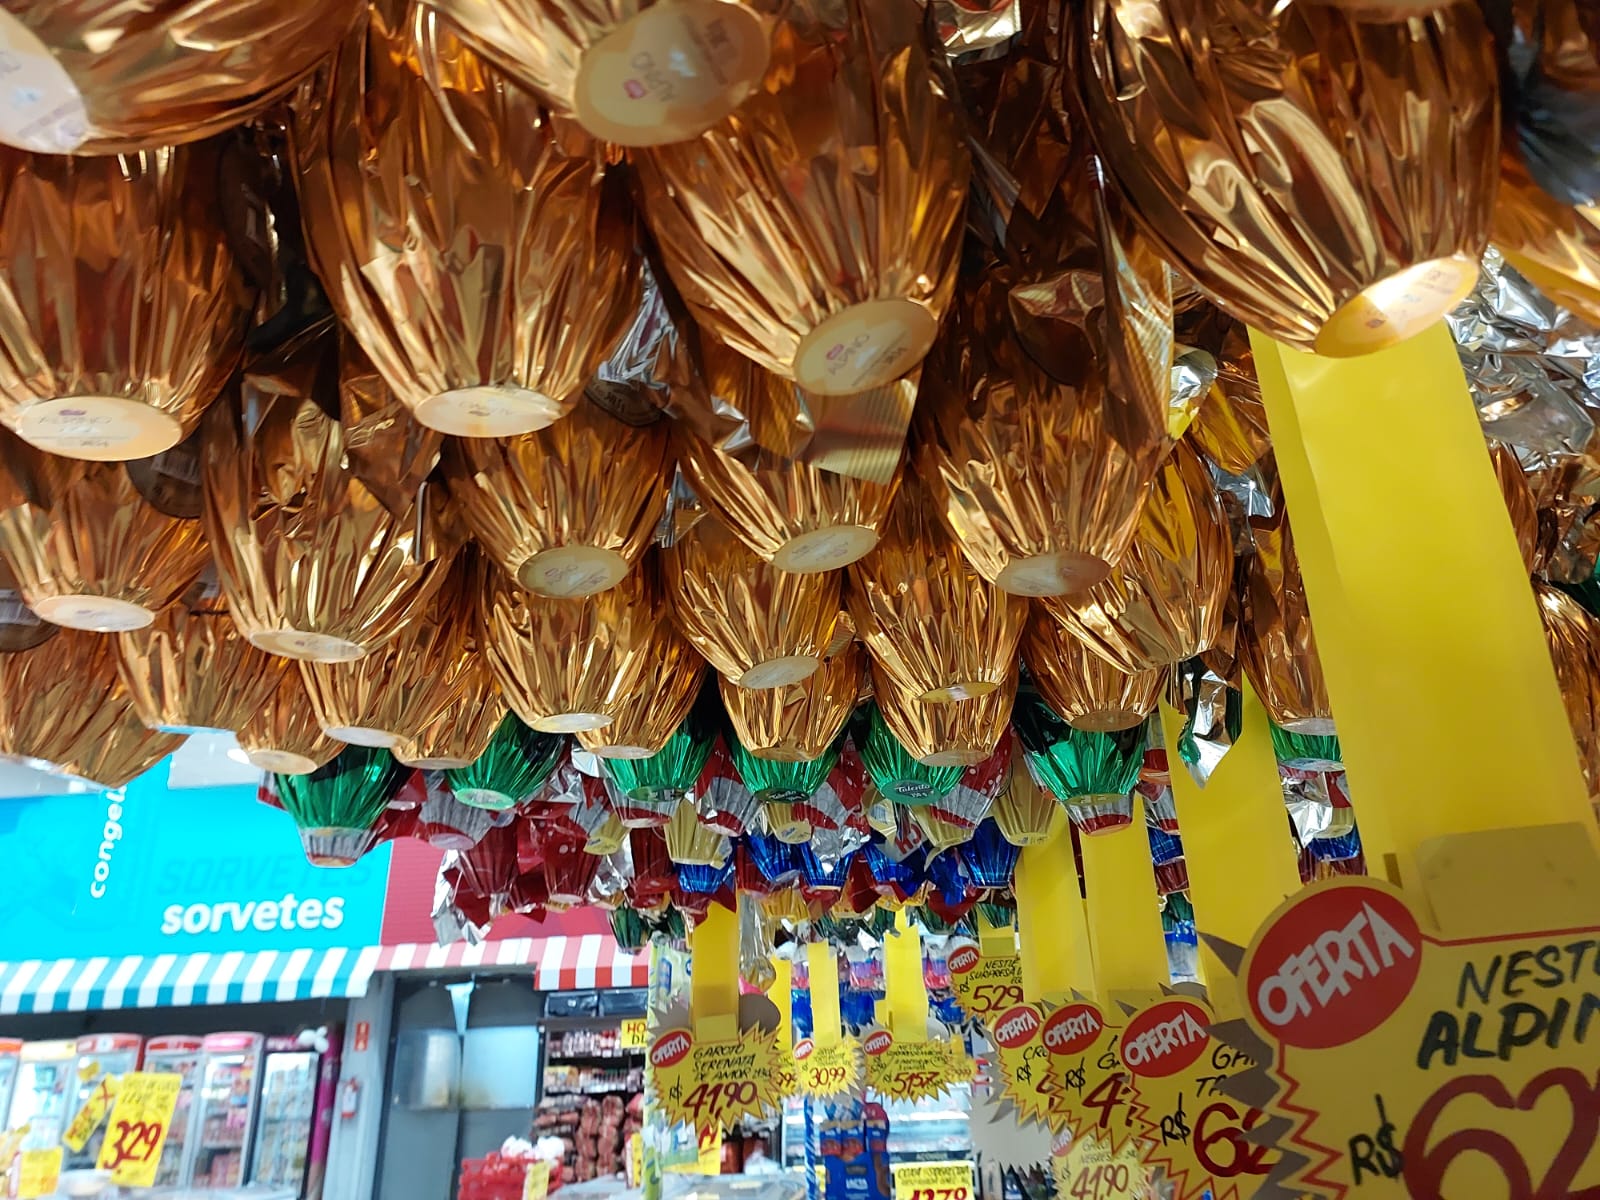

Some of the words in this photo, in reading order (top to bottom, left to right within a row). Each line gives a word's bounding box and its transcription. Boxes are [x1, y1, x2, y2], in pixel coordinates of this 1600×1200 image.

[90, 784, 127, 898] congel
[161, 893, 345, 934] sorvetes
[949, 950, 978, 970] OFERTA
[1258, 901, 1415, 1026] OFERTA
[995, 1011, 1037, 1042] OFERTA
[1045, 1010, 1099, 1047] OFERTA
[1124, 1009, 1208, 1066] OFERTA
[652, 1035, 690, 1064] OFERTA
[1065, 1057, 1086, 1097] R$
[682, 1081, 758, 1120] 41,90
[1160, 1092, 1191, 1146] R$
[1349, 1094, 1404, 1186] R$
